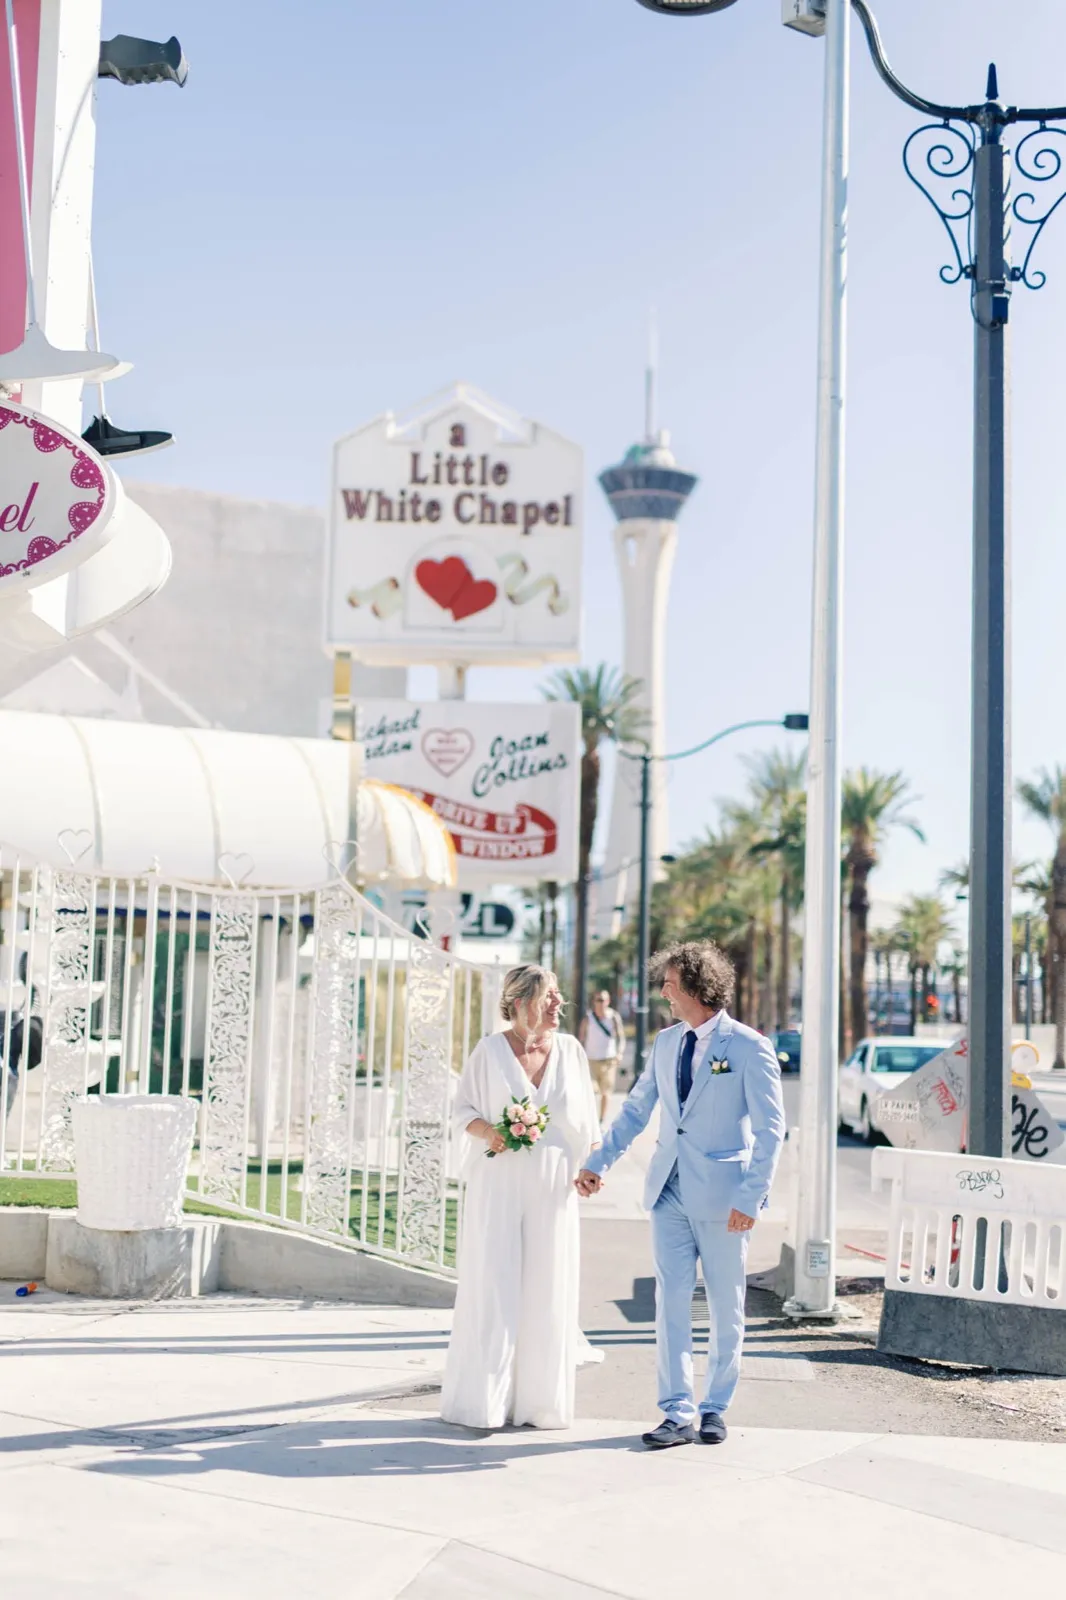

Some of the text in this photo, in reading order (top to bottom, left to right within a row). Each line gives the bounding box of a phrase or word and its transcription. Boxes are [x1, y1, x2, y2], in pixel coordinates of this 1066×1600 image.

[449, 422, 466, 447] a
[410, 451, 509, 486] Little
[341, 488, 573, 535] White Chapel
[490, 731, 548, 770] Joan
[472, 752, 567, 798] Collins
[432, 797, 521, 833] DRIVE UP
[461, 838, 546, 858] WINDOW
